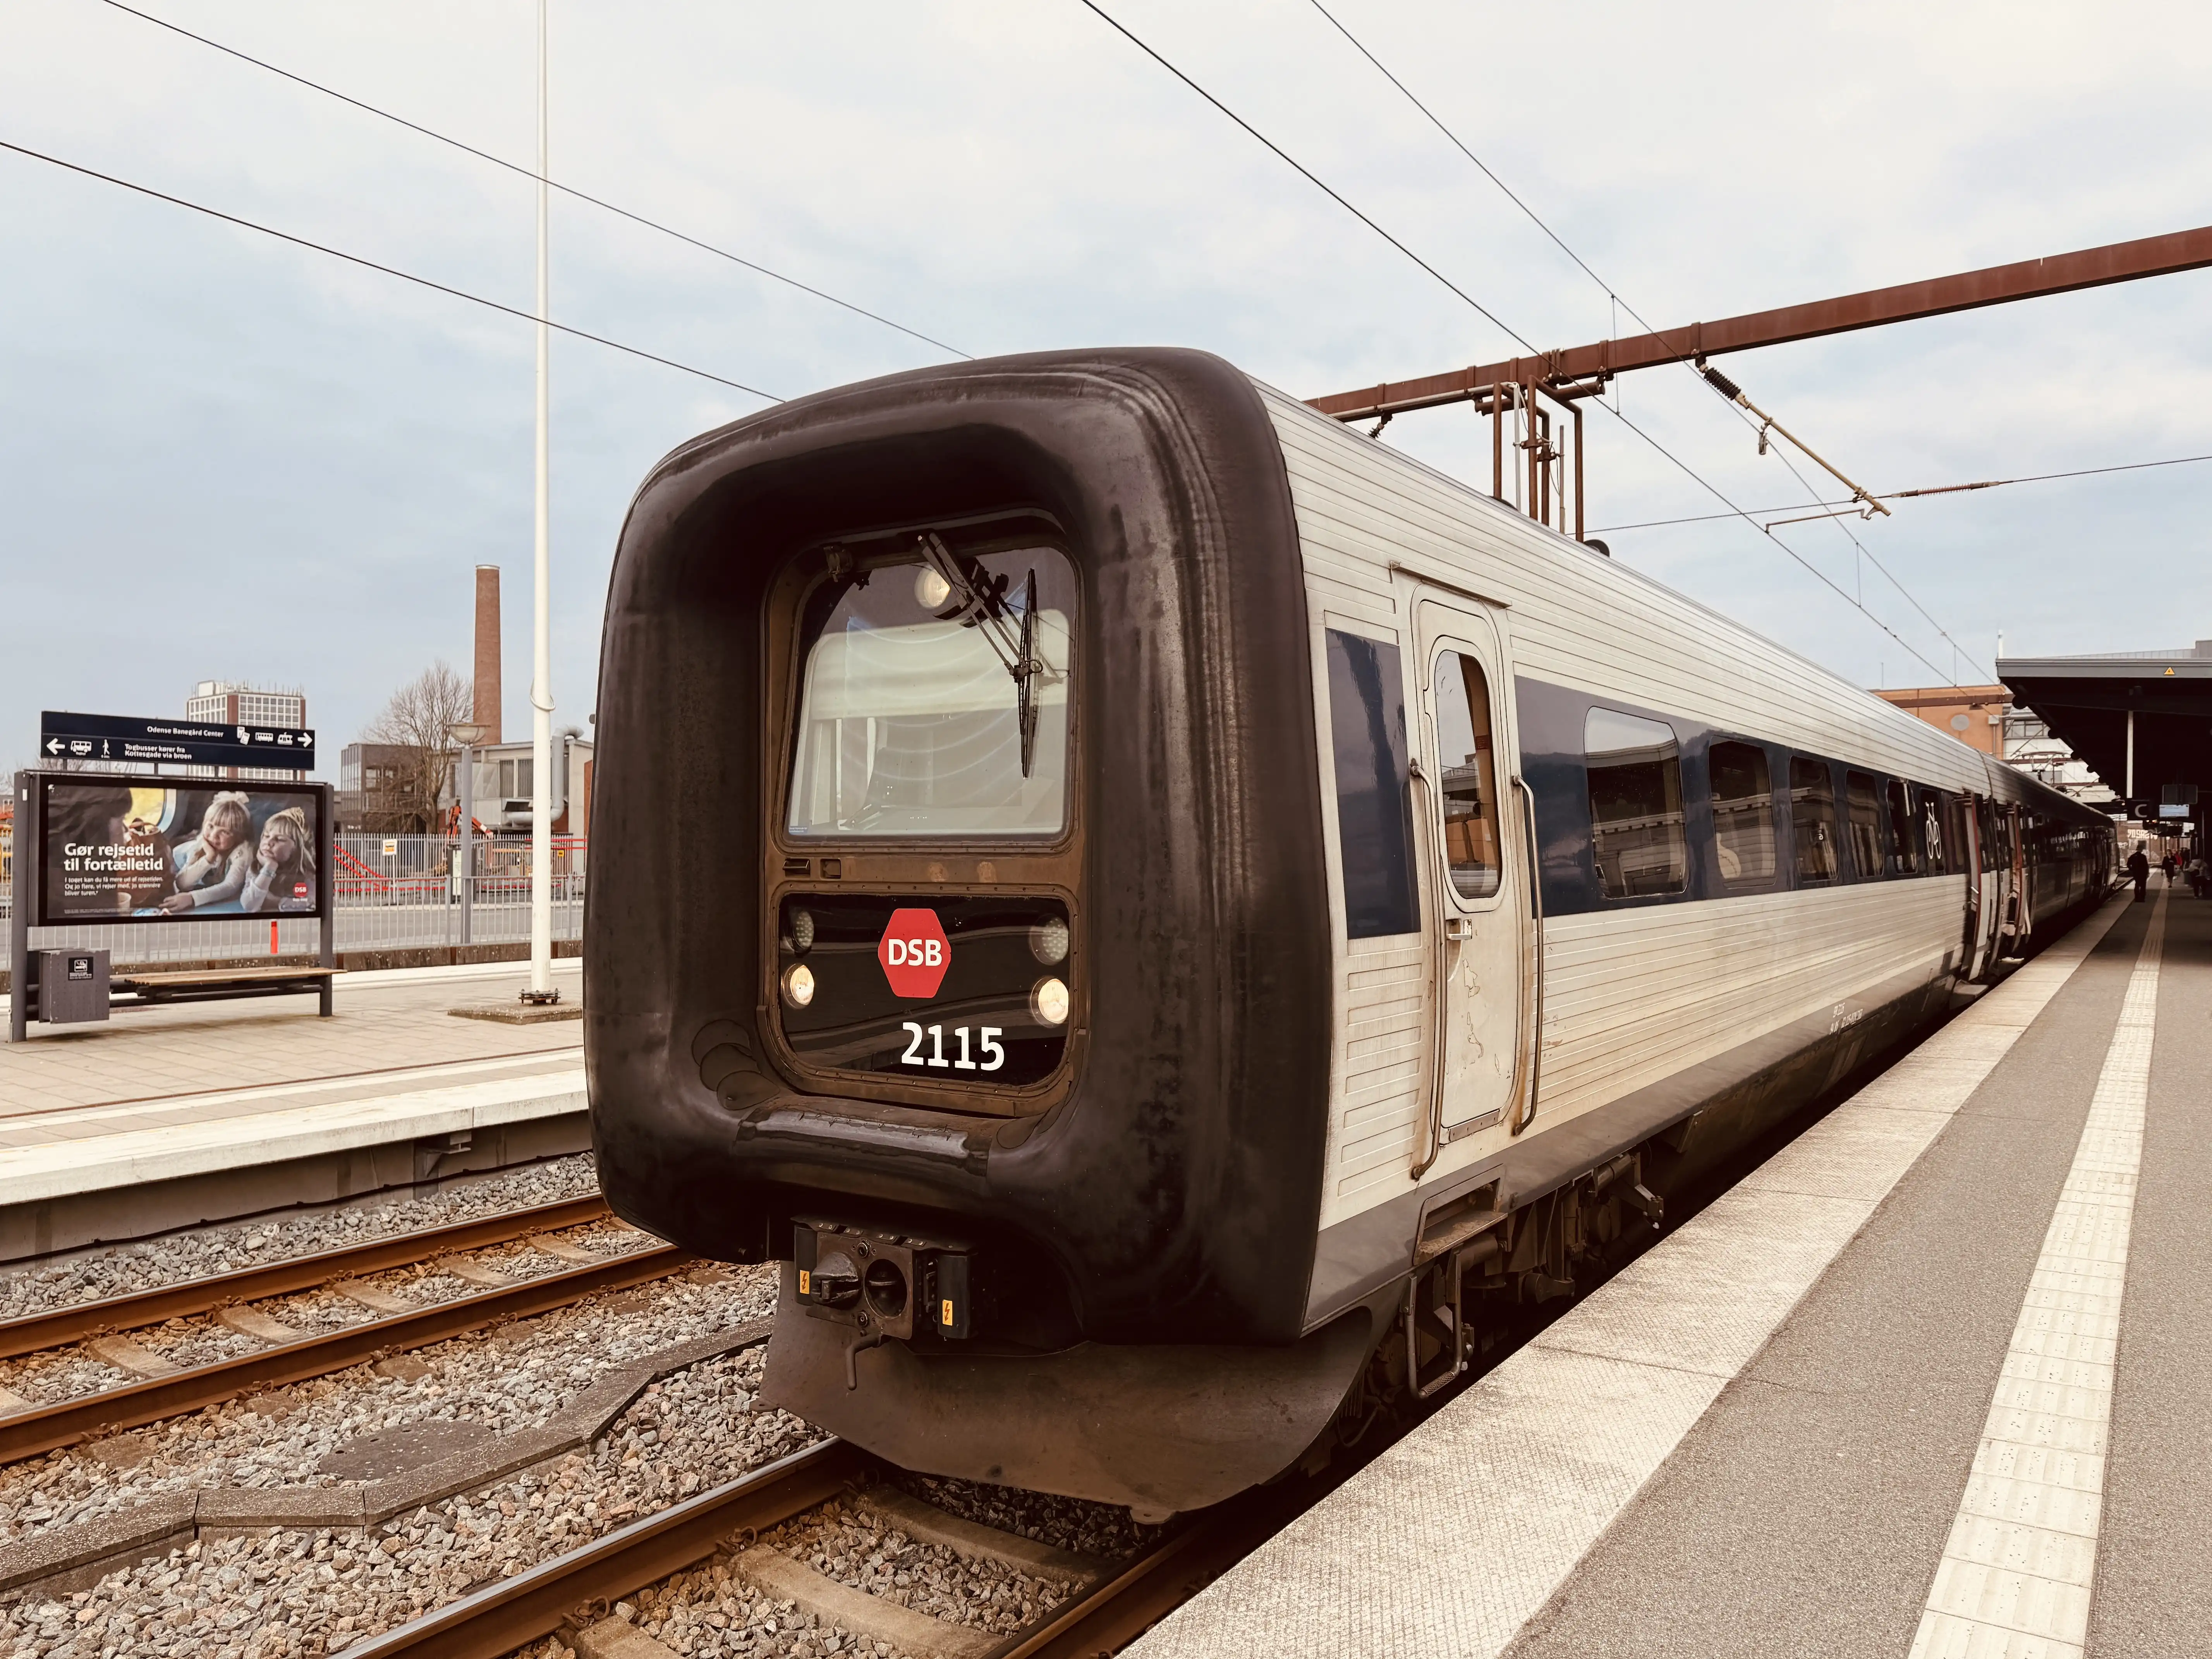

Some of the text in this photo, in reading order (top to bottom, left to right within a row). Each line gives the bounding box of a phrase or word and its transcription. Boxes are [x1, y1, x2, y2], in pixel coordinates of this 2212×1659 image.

[147, 726, 224, 738] Odense Banegård Center
[124, 743, 158, 752] Togbusser
[2135, 804, 2147, 817] C
[65, 843, 154, 859] Gør rejsetid
[64, 857, 163, 871] til fortælletid
[888, 939, 943, 966] DSB
[902, 1022, 1005, 1071] 2115
